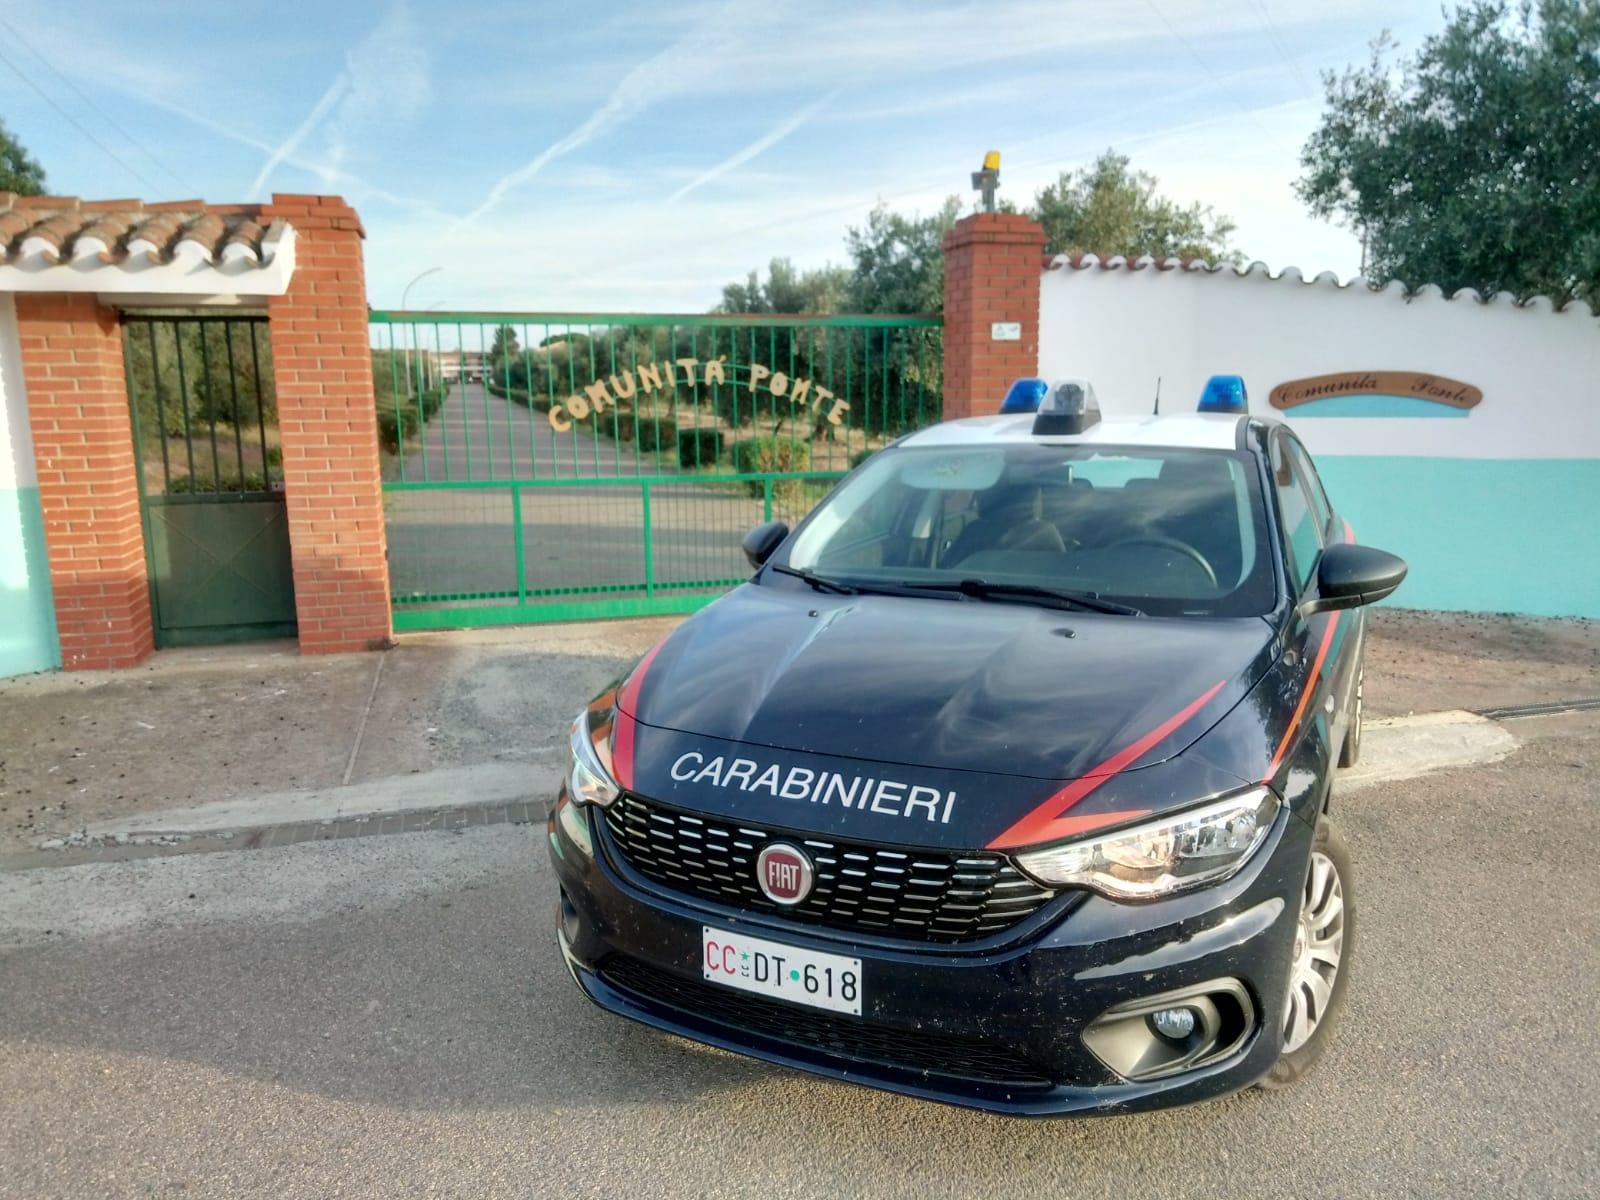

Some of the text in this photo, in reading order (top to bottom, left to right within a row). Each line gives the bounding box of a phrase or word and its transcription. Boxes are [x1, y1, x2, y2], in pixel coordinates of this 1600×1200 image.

[749, 363, 850, 425] PONTE
[670, 751, 957, 824] CARABINIERI
[768, 860, 799, 891] FIAT
[706, 941, 857, 1002] CC DT 618
